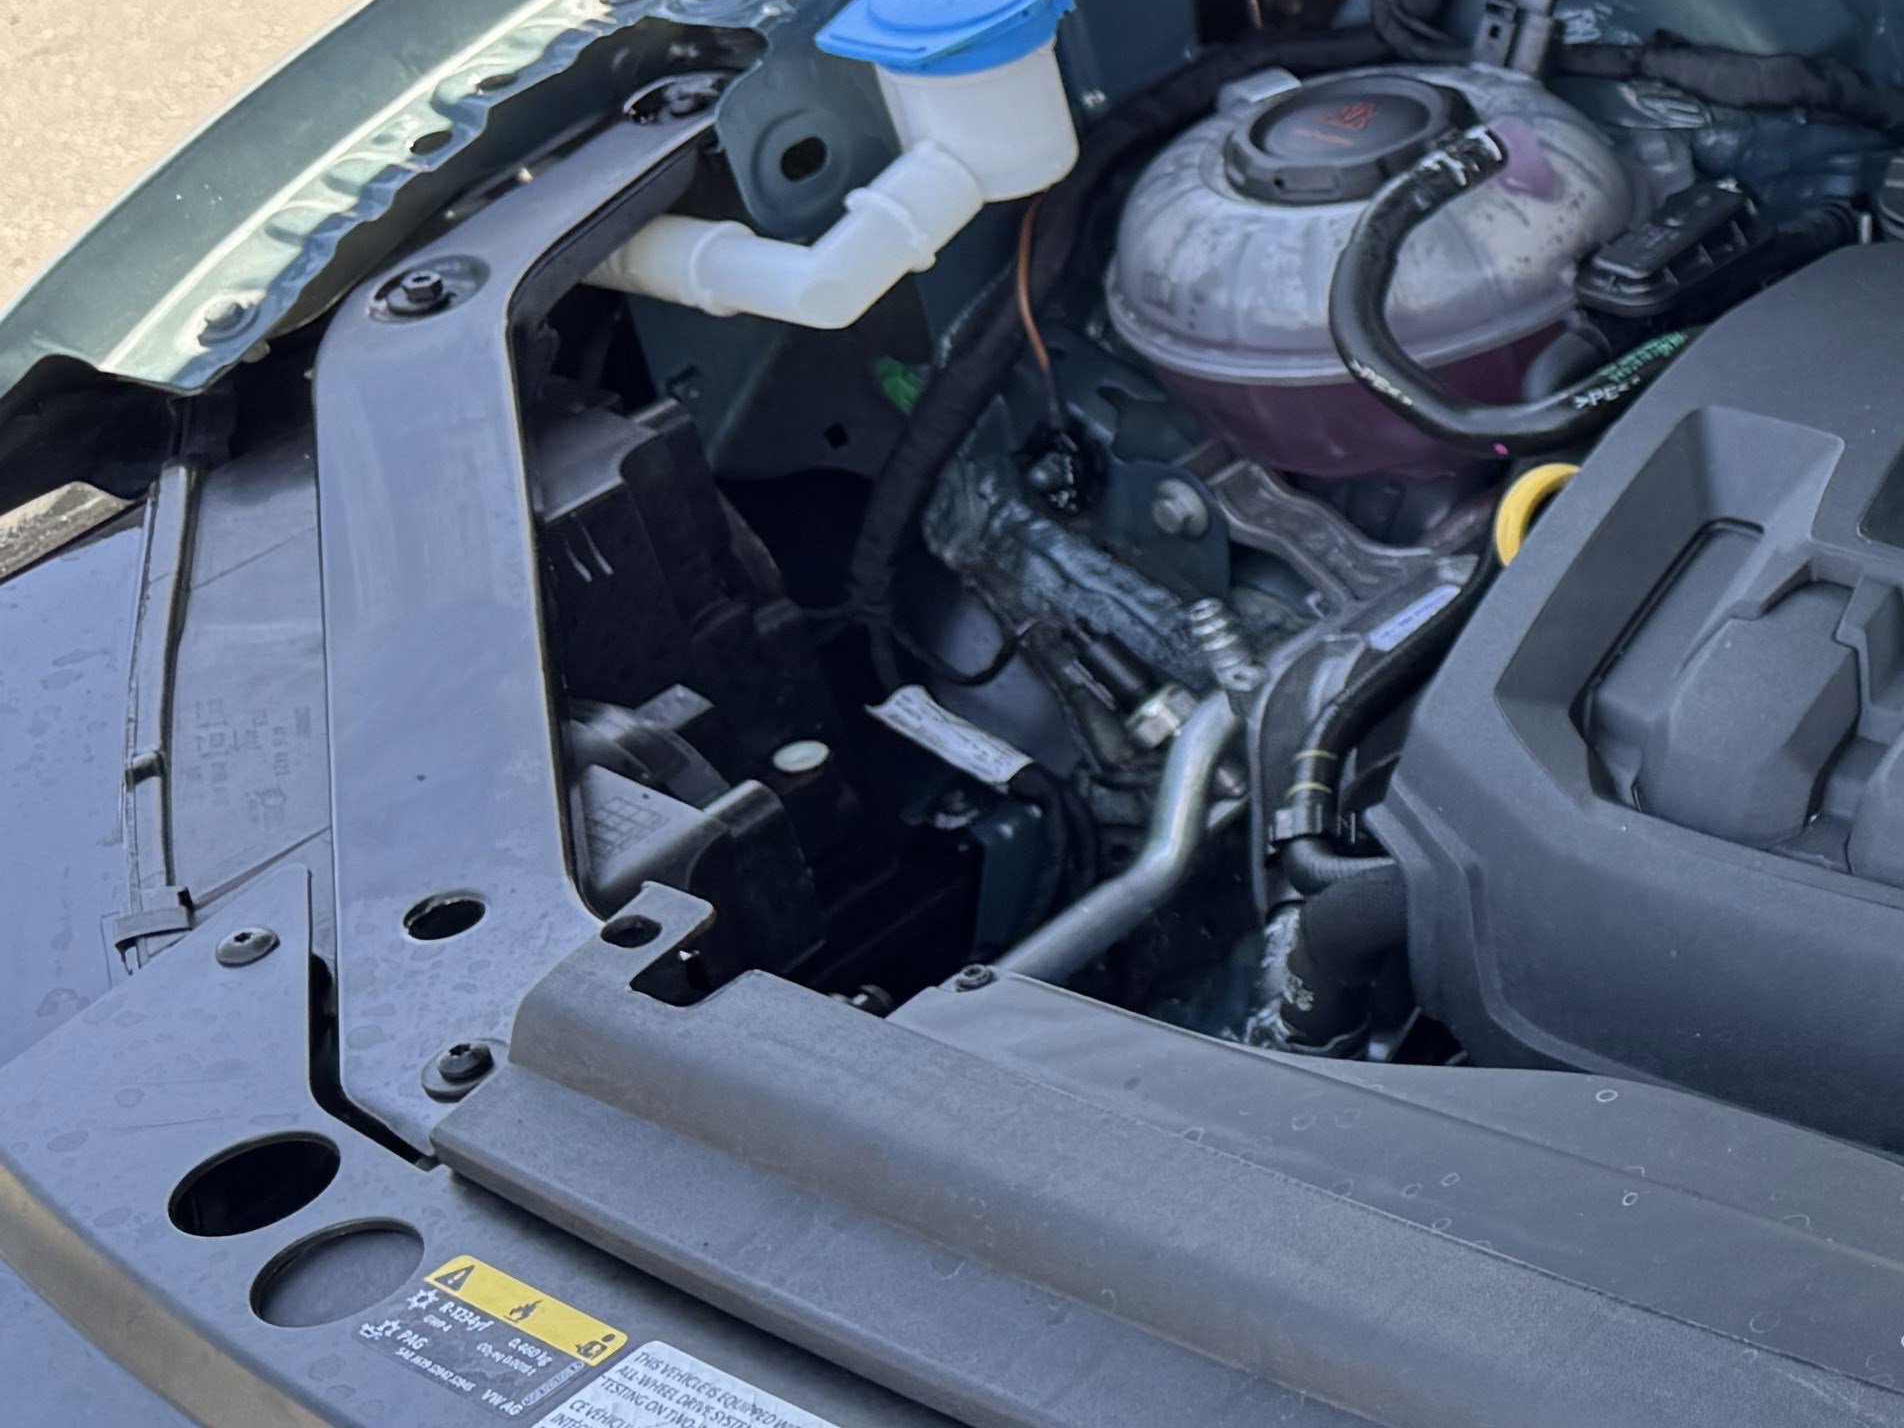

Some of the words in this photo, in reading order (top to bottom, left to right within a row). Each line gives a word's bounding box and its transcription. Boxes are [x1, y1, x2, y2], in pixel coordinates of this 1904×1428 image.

[397, 1330, 428, 1350] PAG
[482, 1390, 507, 1406] VW
[500, 1401, 524, 1416] AG
[599, 1378, 648, 1405] TESTING
[645, 1400, 667, 1415] ON
[616, 1365, 681, 1399] ALL-WHEEL
[676, 1394, 714, 1415] DRIVE
[633, 1352, 664, 1370] THIS
[659, 1364, 711, 1393] VEHICLE
[715, 1392, 778, 1426] EQUIPPED
